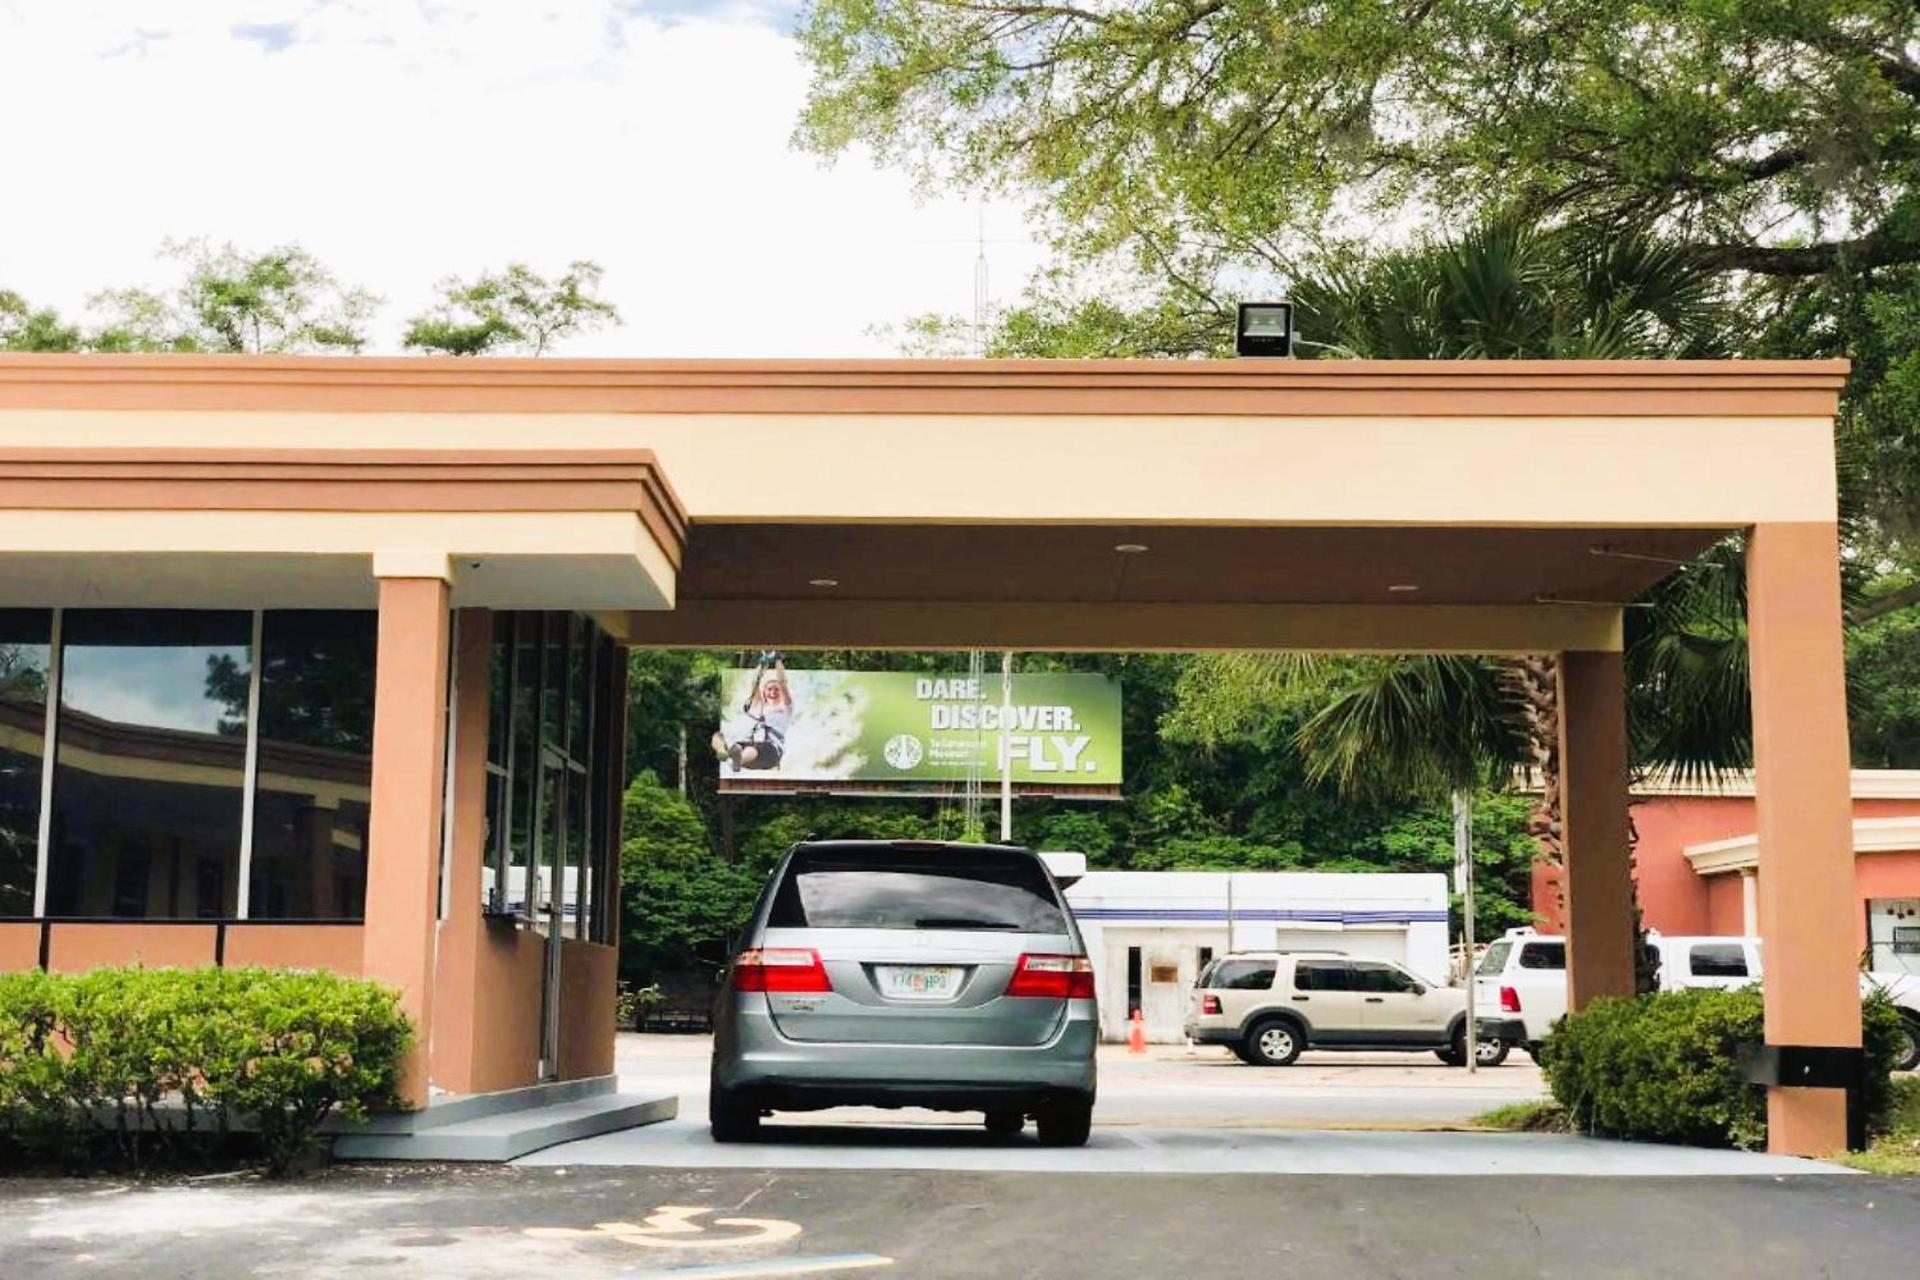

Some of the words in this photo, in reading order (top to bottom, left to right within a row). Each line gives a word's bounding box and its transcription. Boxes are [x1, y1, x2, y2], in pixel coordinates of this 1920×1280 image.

[916, 678, 987, 700] DARE.
[931, 704, 1081, 732] DISCOVER.
[997, 735, 1097, 772] FLY.
